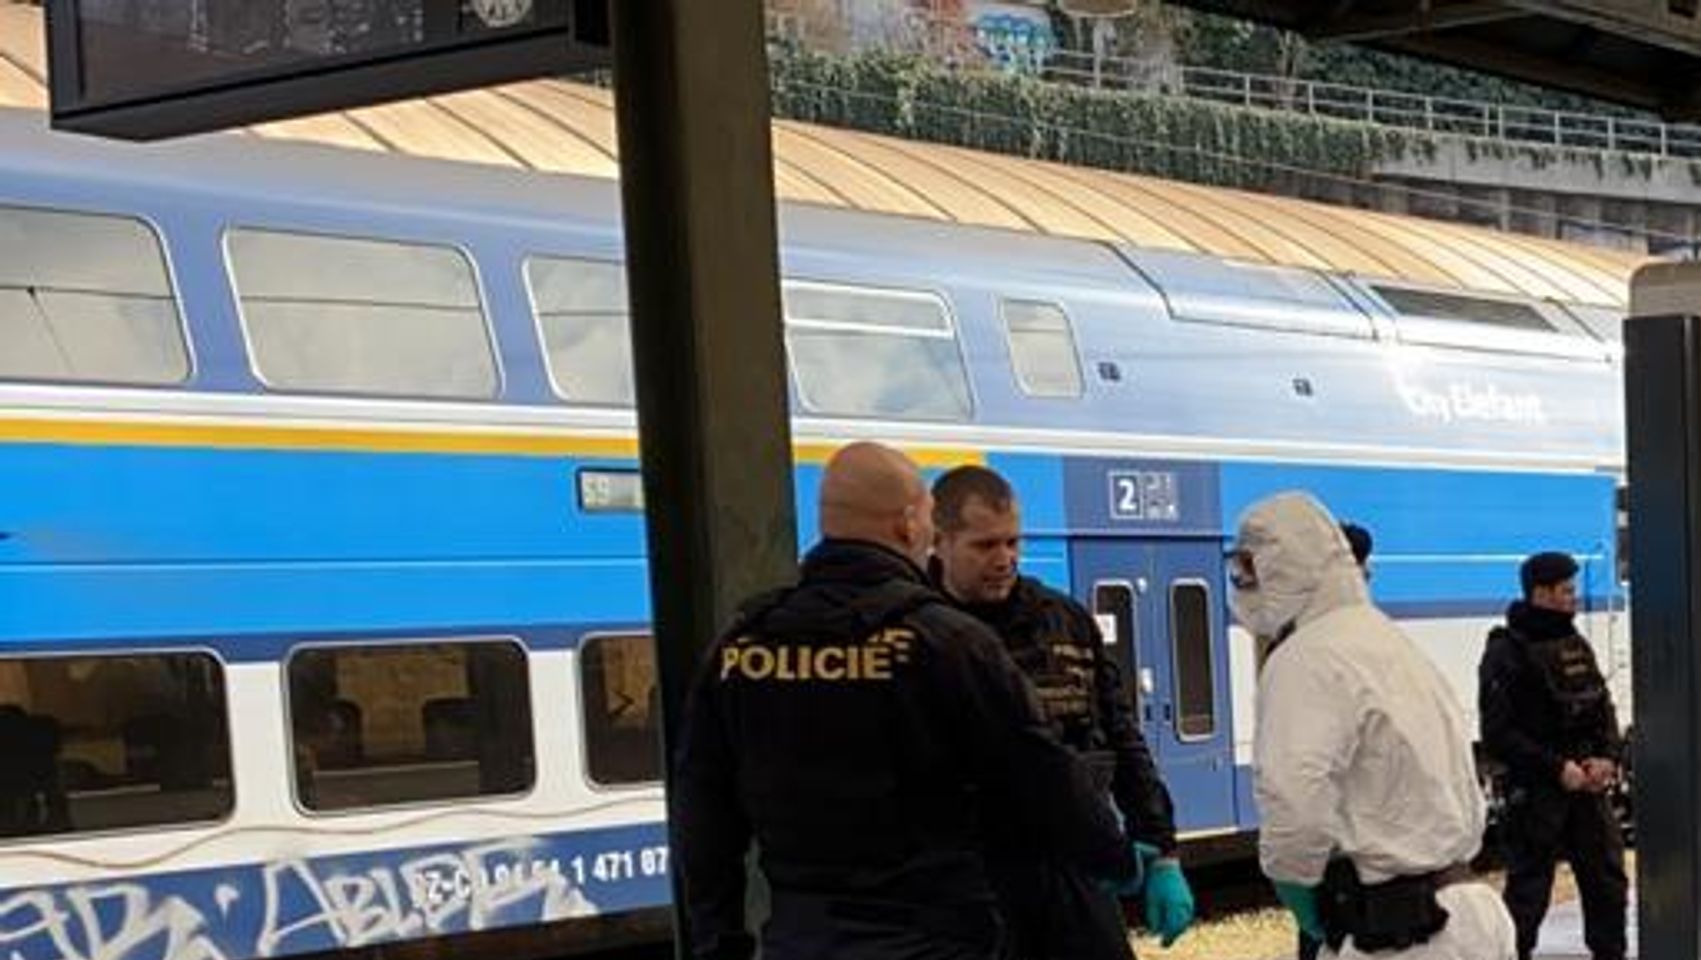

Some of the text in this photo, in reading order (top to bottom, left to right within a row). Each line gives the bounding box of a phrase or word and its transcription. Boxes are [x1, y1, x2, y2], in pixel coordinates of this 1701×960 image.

[1117, 477, 1136, 511] 2
[720, 644, 893, 680] POLICIE
[572, 856, 584, 884] 1
[593, 850, 634, 882] 471
[641, 846, 668, 876] 07
